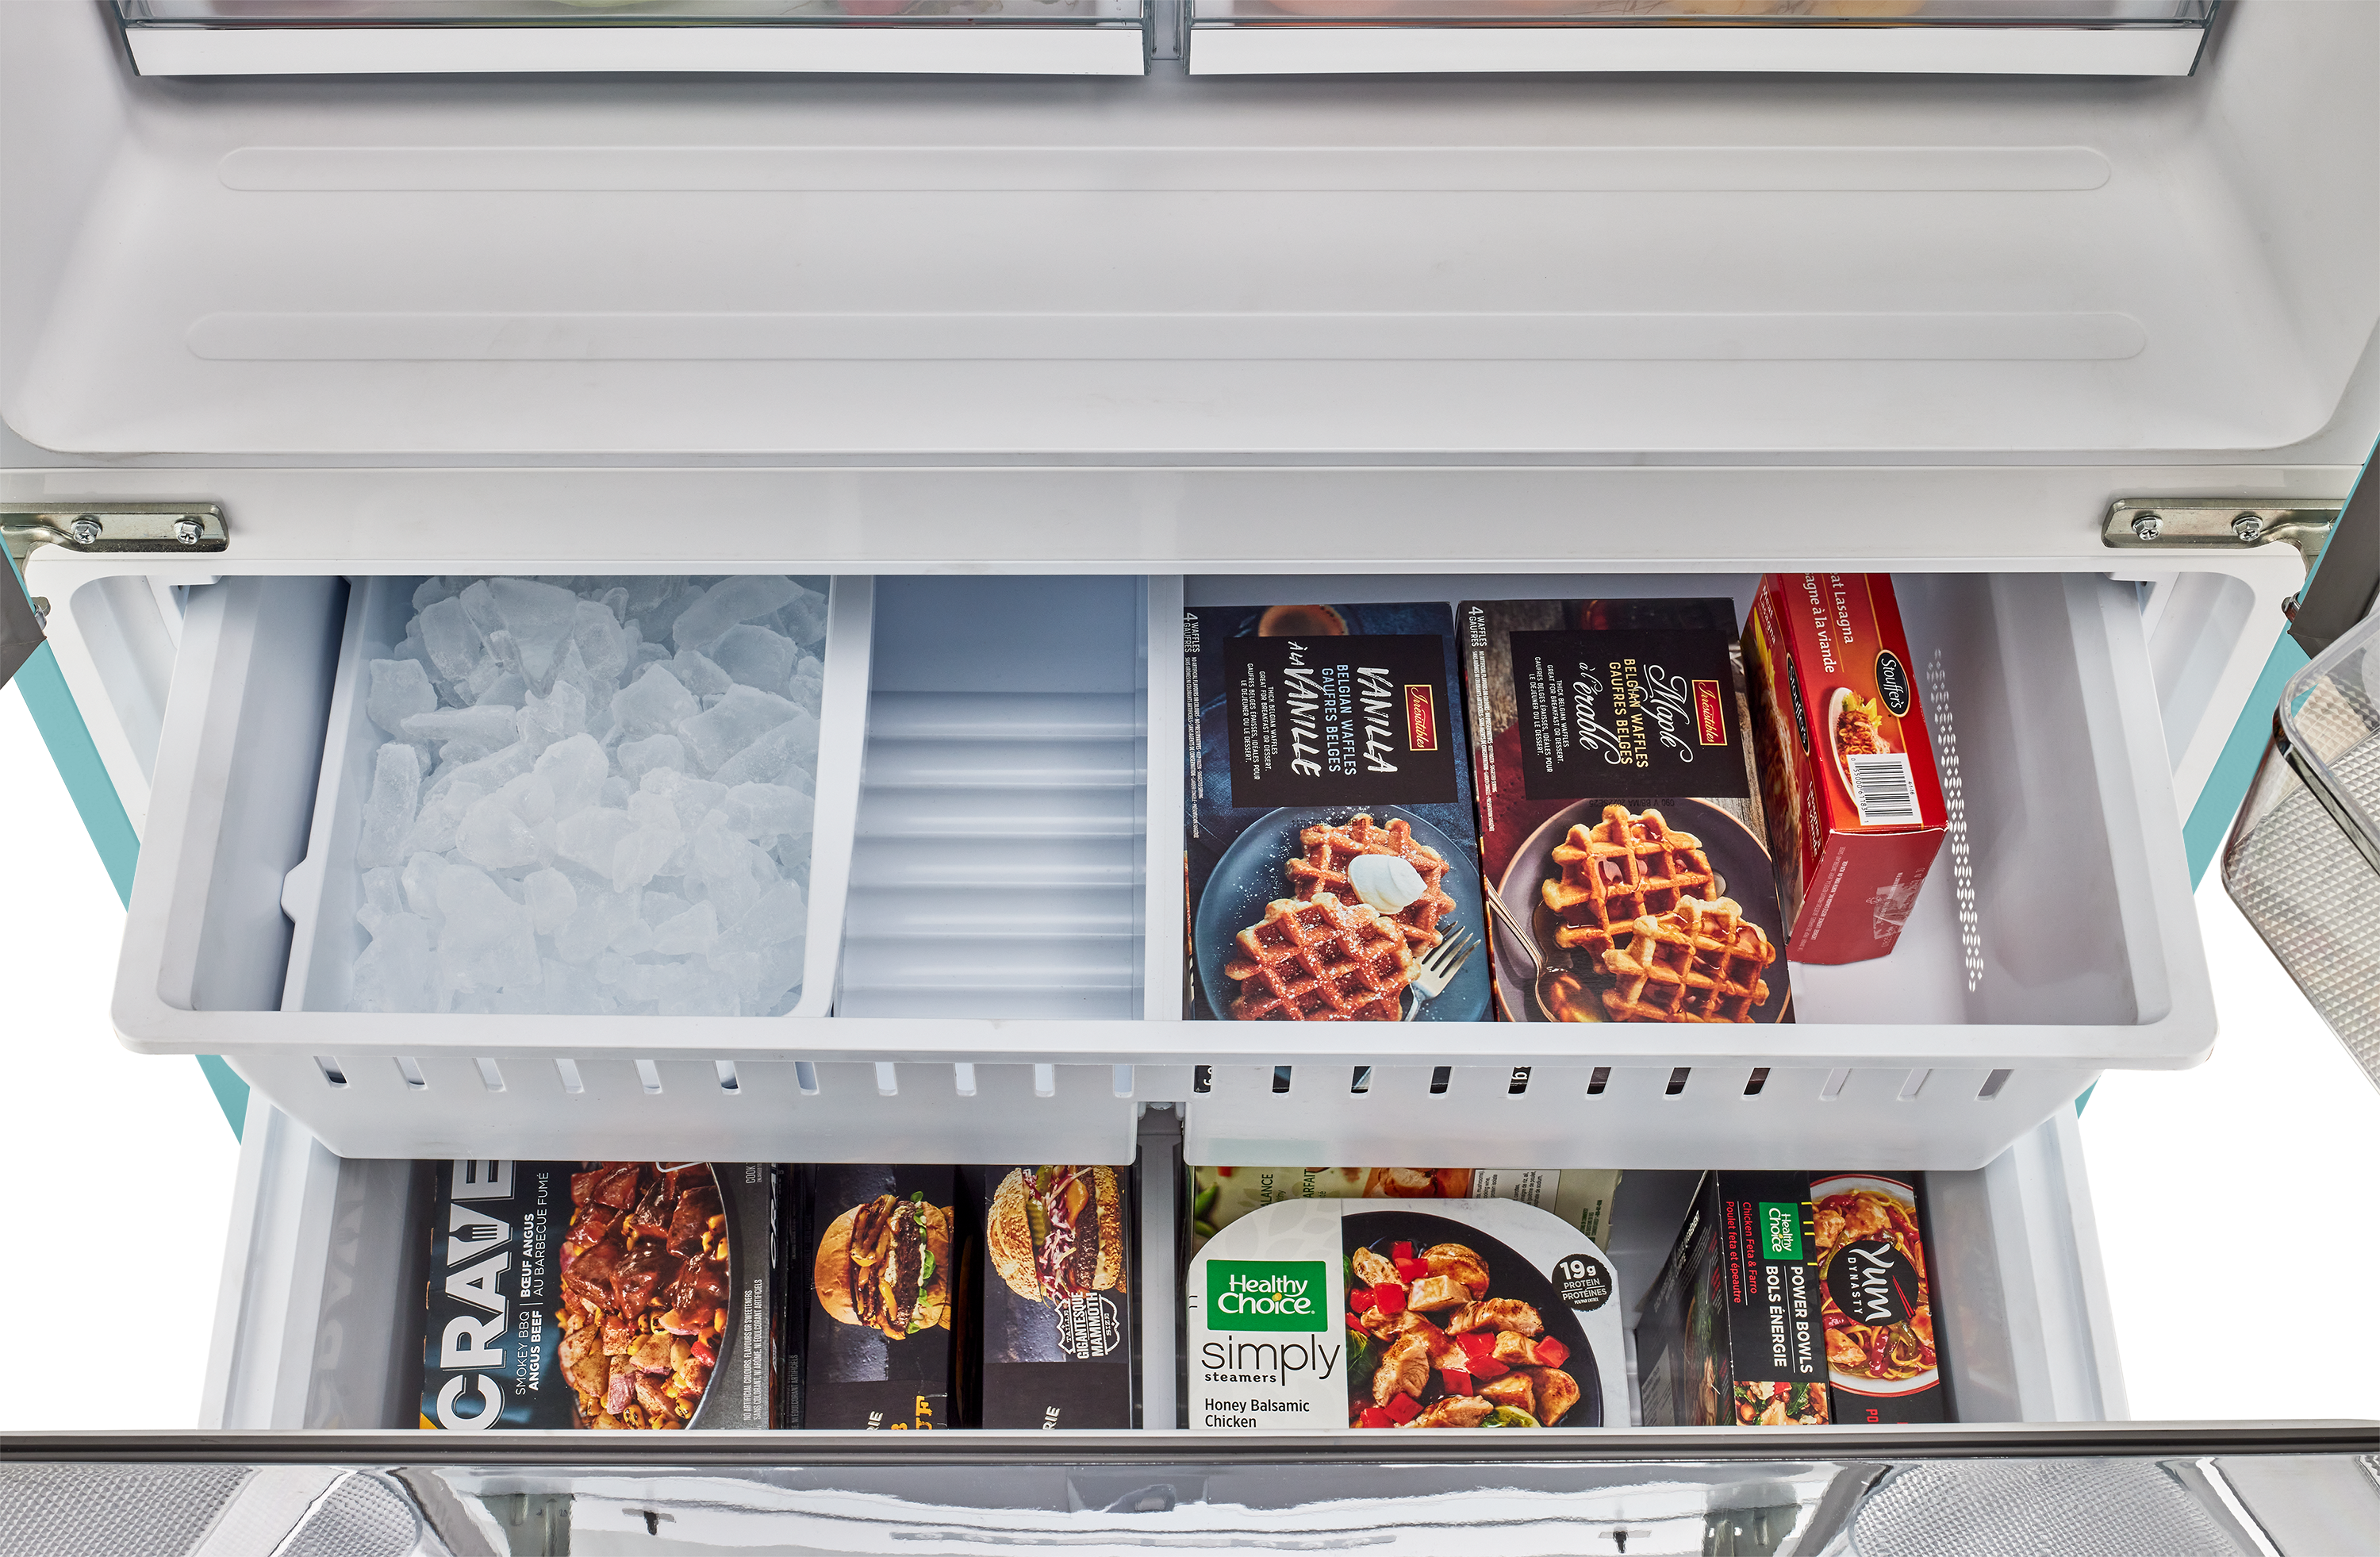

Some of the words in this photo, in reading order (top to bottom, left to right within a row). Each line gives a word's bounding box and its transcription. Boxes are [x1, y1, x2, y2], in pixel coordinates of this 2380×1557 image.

[1184, 612, 1198, 621] 4
[1468, 606, 1484, 615] 4
[1762, 586, 1773, 619] Meat
[1834, 591, 1853, 644] Lasagna
[1469, 616, 1479, 647] GAUFRES
[1476, 616, 1487, 647] WAFFLES
[1760, 593, 1775, 646] Lasagna
[1814, 616, 1828, 629] la
[1192, 622, 1200, 652] WAFFLES
[1818, 630, 1837, 673] viande
[1534, 657, 1544, 681] GAUFRES
[1624, 659, 1641, 708] BELGIAN
[1881, 658, 1904, 709] Stouffer's
[1322, 667, 1338, 722] GAUFRES
[1337, 664, 1353, 713] BELGIAN
[1609, 662, 1627, 716] GAUFRES
[1242, 717, 1250, 727] OU
[1284, 667, 1329, 778] VANILLE
[1357, 667, 1398, 773] VANILLA
[1411, 686, 1430, 748] Irresistibles
[1533, 711, 1539, 720] OU
[1539, 705, 1549, 732] ÉPAISSES,
[1550, 695, 1560, 726] BREAKFAST
[1636, 664, 1693, 763] Maple
[1699, 682, 1718, 743] Irresistibles
[1341, 719, 1357, 776] WAFFLES
[1535, 729, 1544, 755] DESSERT.
[1542, 733, 1552, 755] IDÉALES
[1553, 728, 1561, 736] OR
[1561, 722, 1570, 748] WAFFLES
[1616, 720, 1633, 765] BELGES
[1630, 713, 1649, 768] WAFFLES
[1263, 744, 1273, 771] DESSERT.
[1326, 726, 1342, 773] BELGES
[1555, 738, 1564, 763] DESSERT.
[1853, 769, 1864, 788] 55000
[1858, 791, 1868, 811] 61183
[536, 1172, 549, 1205] FUMÉ
[746, 1166, 756, 1184] COOK
[1726, 1201, 1736, 1229] Poulet
[1743, 1201, 1752, 1236] Chicken
[1768, 1208, 1783, 1252] Choice
[523, 1213, 535, 1258] ANGUS
[534, 1209, 547, 1275] BARBECUE
[1729, 1232, 1737, 1249] feta
[1781, 1213, 1794, 1251] Healthy
[1729, 1252, 1738, 1261] et
[1746, 1239, 1755, 1259] Feta
[436, 1159, 516, 1429] CRAVE
[520, 1260, 532, 1298] BŒUF
[533, 1279, 545, 1297] AU
[1229, 1274, 1308, 1298] Healthy
[1562, 1288, 1607, 1301] PROTÉINES
[1564, 1278, 1600, 1290] PROTEIN
[1730, 1265, 1741, 1303] épeautre
[1749, 1270, 1757, 1294] Farro
[1765, 1266, 1781, 1303] BOLS
[1791, 1266, 1808, 1318] POWER
[1847, 1257, 1864, 1314] DYNASTY
[1848, 1243, 1894, 1322] Yum
[518, 1311, 530, 1338] BBQ
[531, 1311, 542, 1342] BEEF
[1071, 1291, 1090, 1359] GIGANTESQUE
[1085, 1292, 1104, 1357] MAMMOTH
[1769, 1305, 1787, 1367] ÉNERGIE
[1201, 1334, 1340, 1386] simply
[1796, 1321, 1814, 1374] BOWLS
[516, 1342, 528, 1395] SMOKEY
[528, 1345, 542, 1390] ANGUS
[1204, 1372, 1276, 1382] steamers
[743, 1384, 752, 1412] ARTIFICIAL
[753, 1405, 762, 1421] SANS
[1205, 1398, 1246, 1413] Honey
[1251, 1399, 1310, 1412] Balsamic
[1205, 1415, 1257, 1428] Chicken
